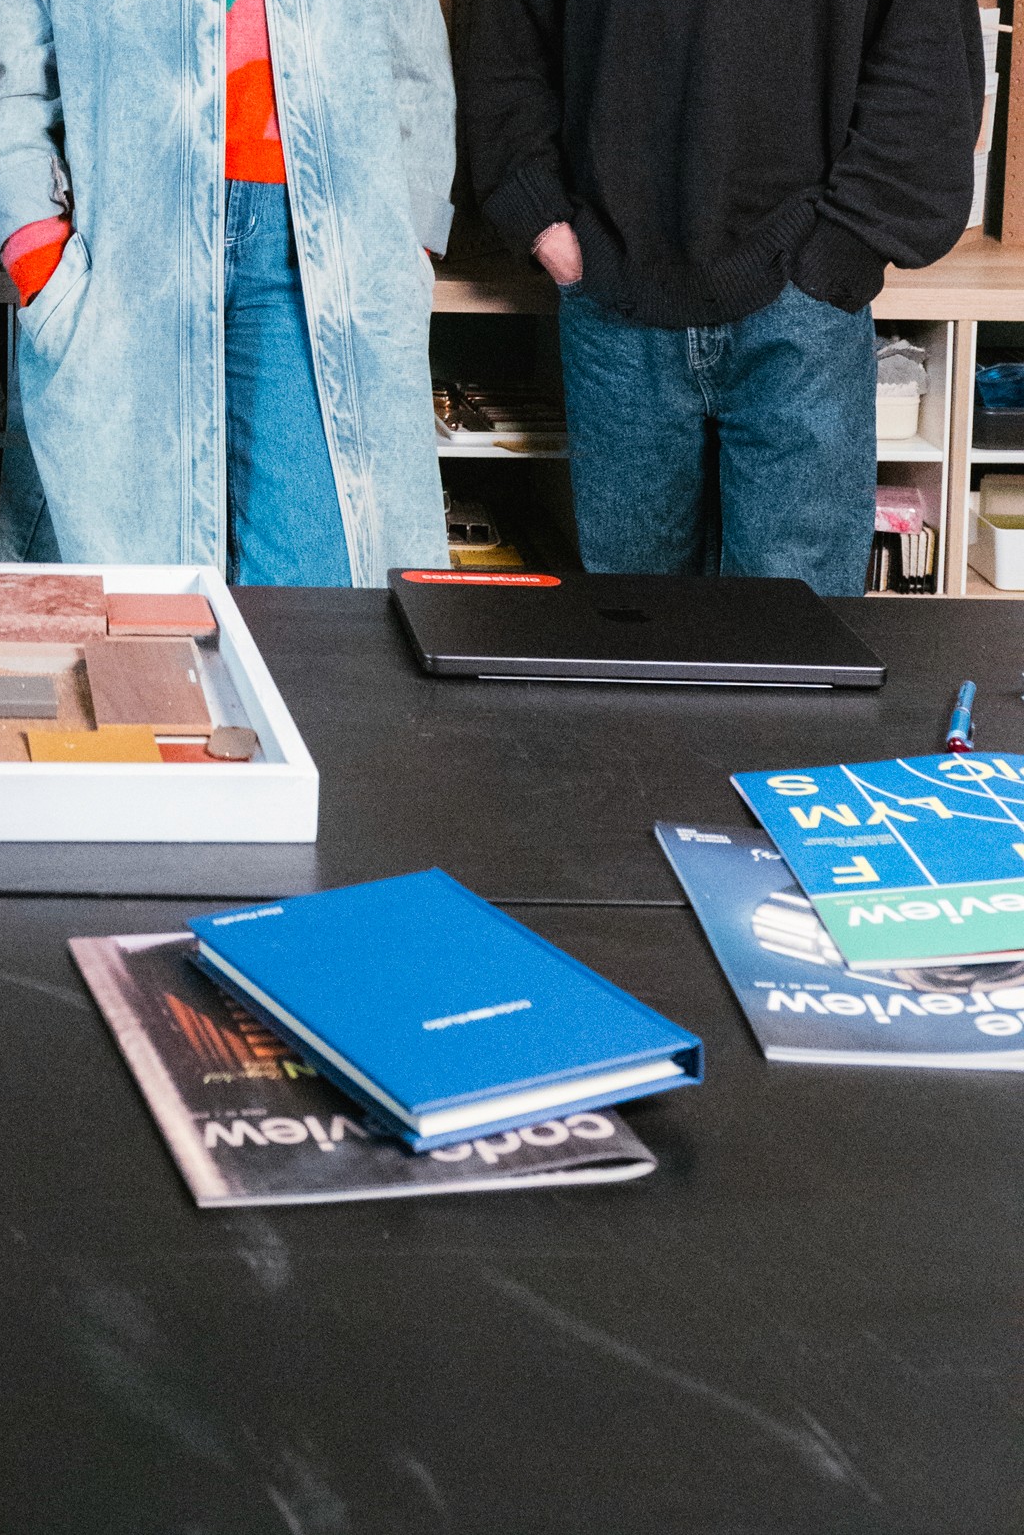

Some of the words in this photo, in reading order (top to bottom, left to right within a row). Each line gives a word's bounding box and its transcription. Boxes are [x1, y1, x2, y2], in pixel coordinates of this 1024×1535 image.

[491, 575, 540, 583] studio
[766, 775, 820, 796] S
[832, 855, 881, 885] F
[767, 989, 988, 1025] review
